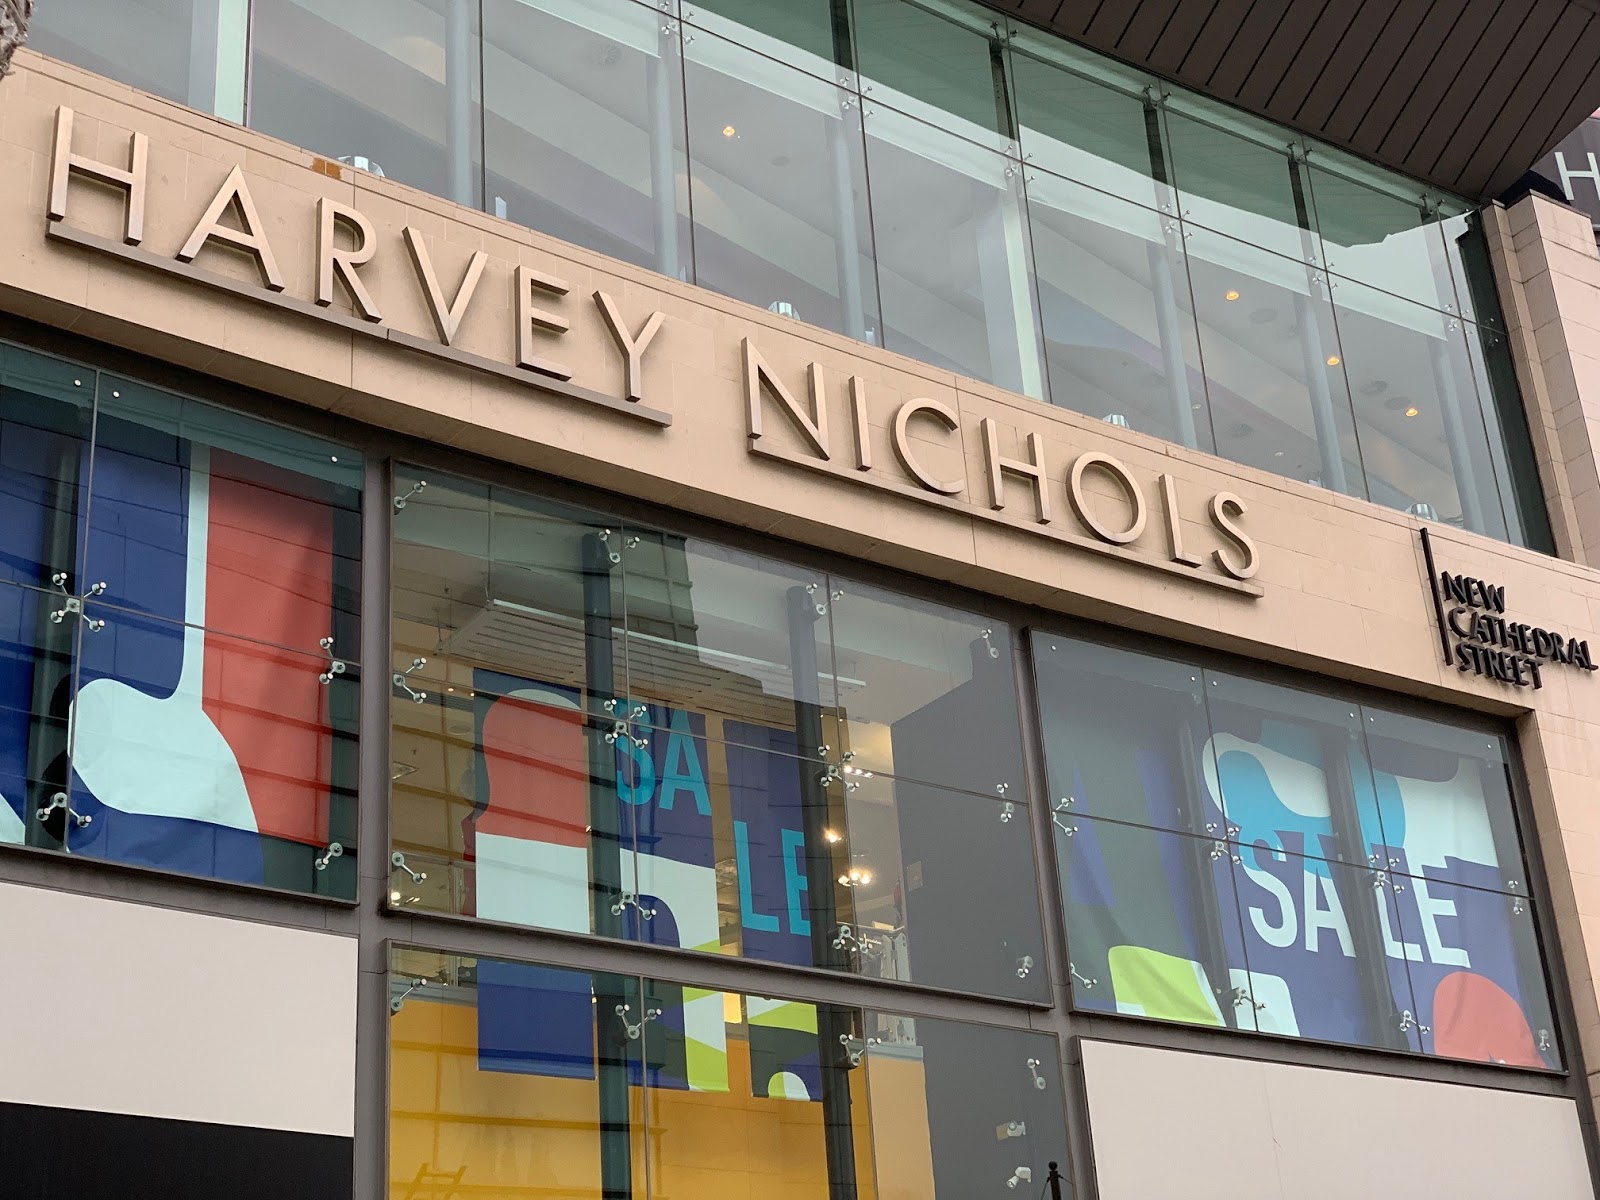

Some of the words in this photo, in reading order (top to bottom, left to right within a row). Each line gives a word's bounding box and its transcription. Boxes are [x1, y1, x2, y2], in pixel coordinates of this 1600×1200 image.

[47, 105, 665, 402] HARVEY
[740, 336, 1261, 580] NICHOLS
[1441, 571, 1505, 614] NEW
[1448, 607, 1599, 671] CATHEDRAL
[1456, 642, 1543, 690] STREET
[1238, 828, 1472, 969] SALE
